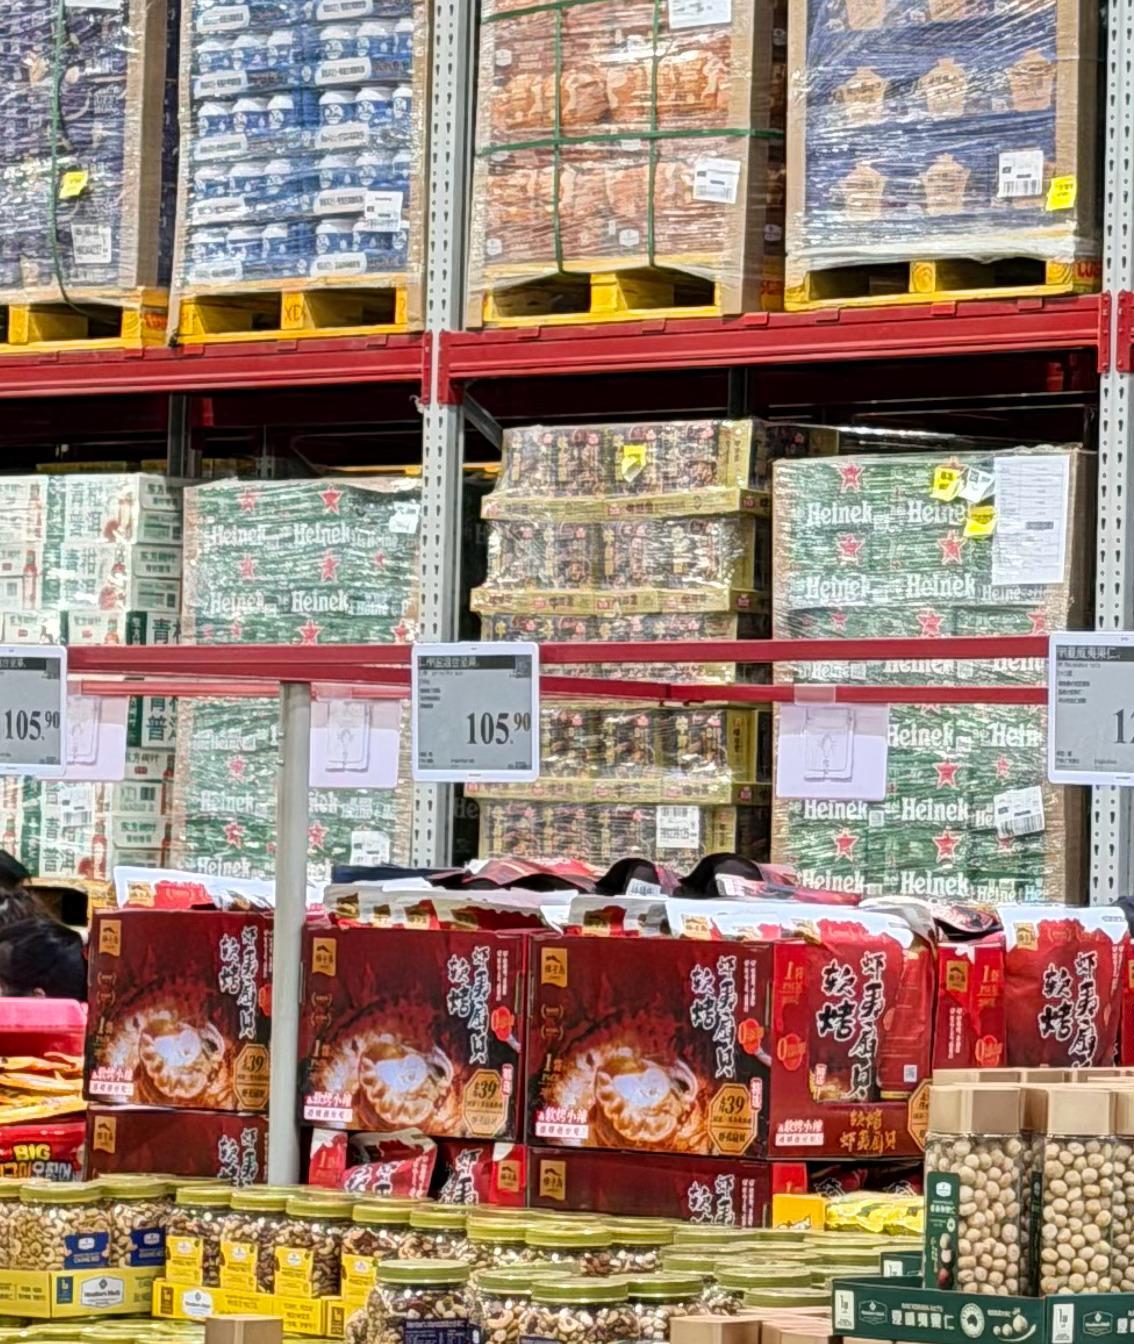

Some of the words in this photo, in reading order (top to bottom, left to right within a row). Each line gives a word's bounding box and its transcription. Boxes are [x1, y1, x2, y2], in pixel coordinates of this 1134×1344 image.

[291, 590, 348, 612] Heinek
[902, 798, 968, 822] Heinek
[901, 871, 969, 896] Heinek
[1038, 963, 1073, 1041] 软烤
[1069, 951, 1099, 1068] 虾夷扇
[13, 1145, 52, 1161] BIG
